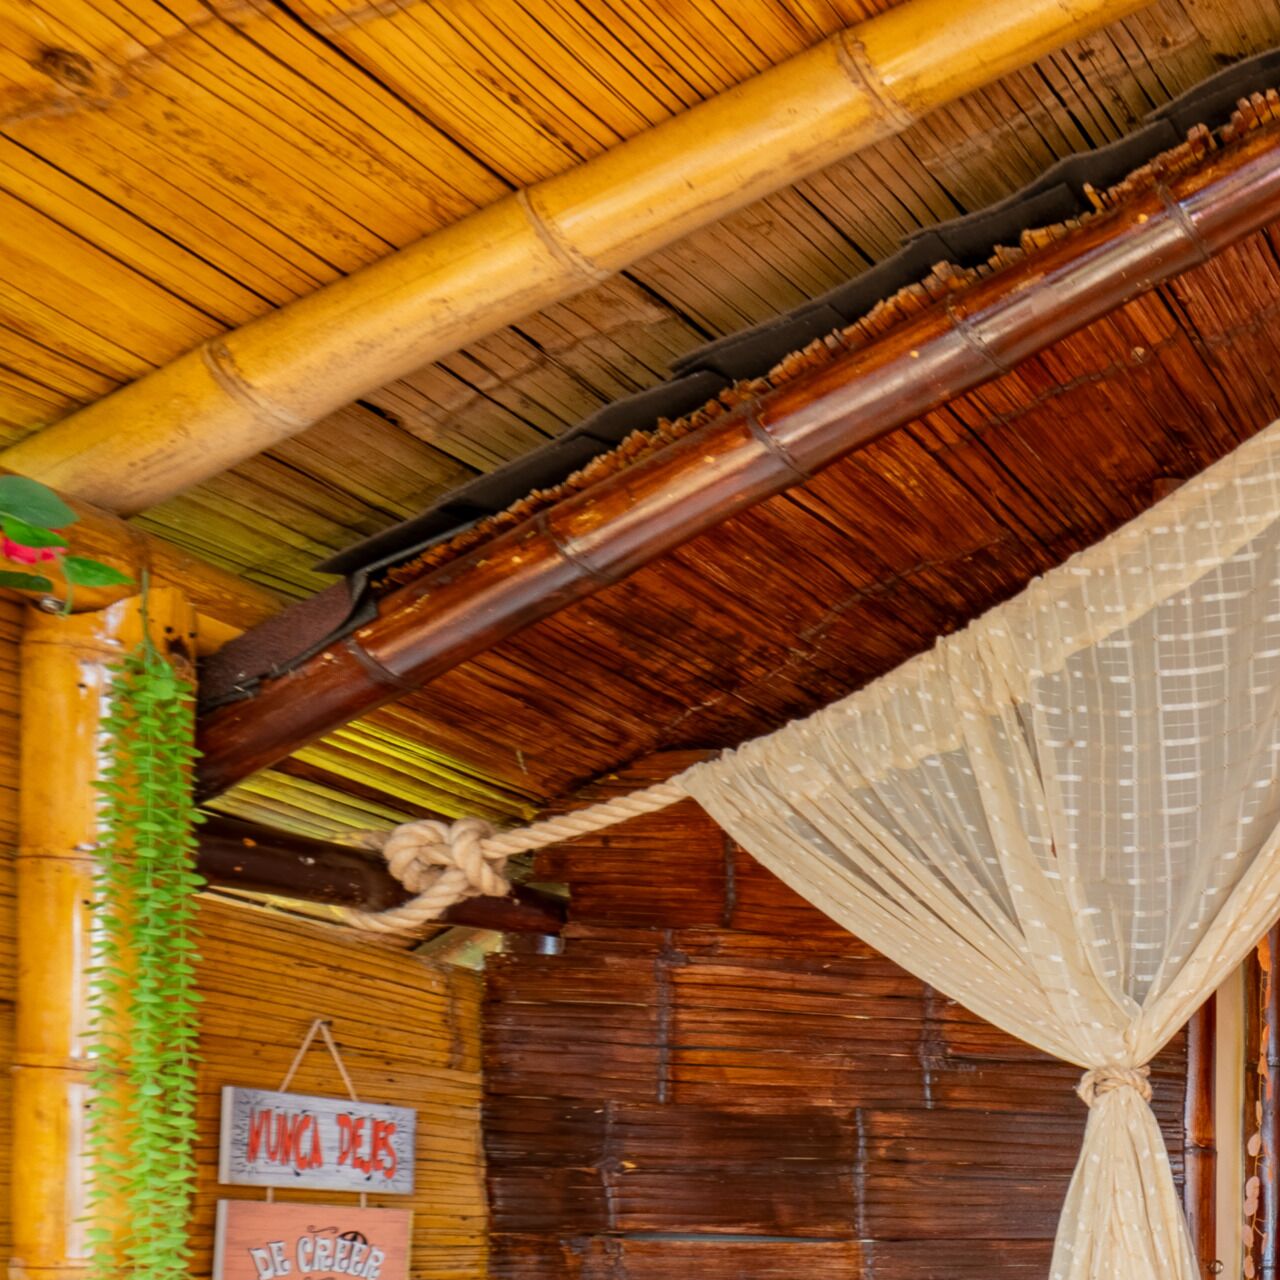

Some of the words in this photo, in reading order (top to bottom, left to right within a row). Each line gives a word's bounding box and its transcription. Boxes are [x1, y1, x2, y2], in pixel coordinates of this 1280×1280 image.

[246, 1107, 323, 1170] NUNCA
[336, 1113, 398, 1180] DEJES
[249, 1240, 292, 1280] DE
